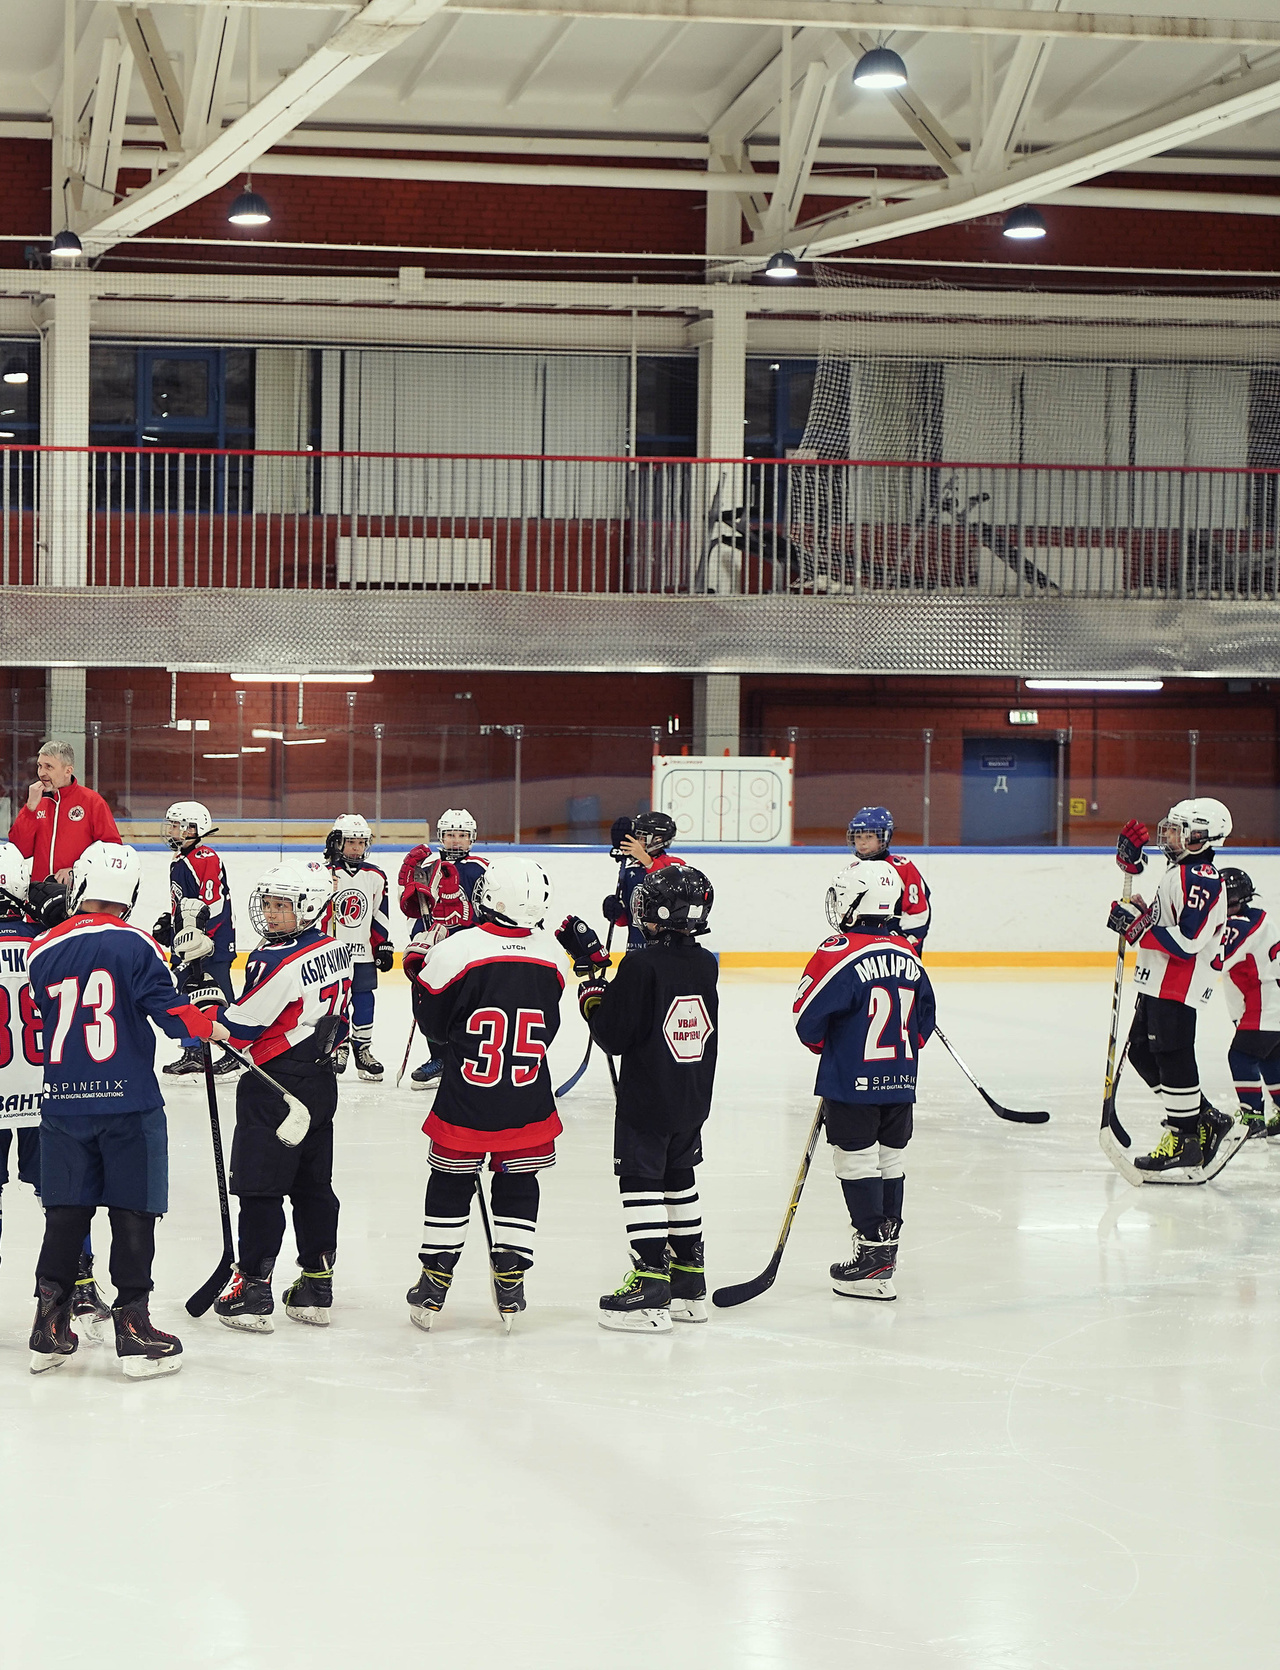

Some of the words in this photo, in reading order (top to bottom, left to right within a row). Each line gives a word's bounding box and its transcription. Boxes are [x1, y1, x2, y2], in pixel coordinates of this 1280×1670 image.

[993, 775, 1009, 794] Д
[111, 857, 122, 869] 73
[880, 876, 891, 886] 24
[908, 883, 919, 905] 8
[43, 968, 118, 1066] 73
[863, 985, 916, 1063] 24
[460, 1006, 546, 1088] 35
[52, 1079, 123, 1093] SPINETIX
